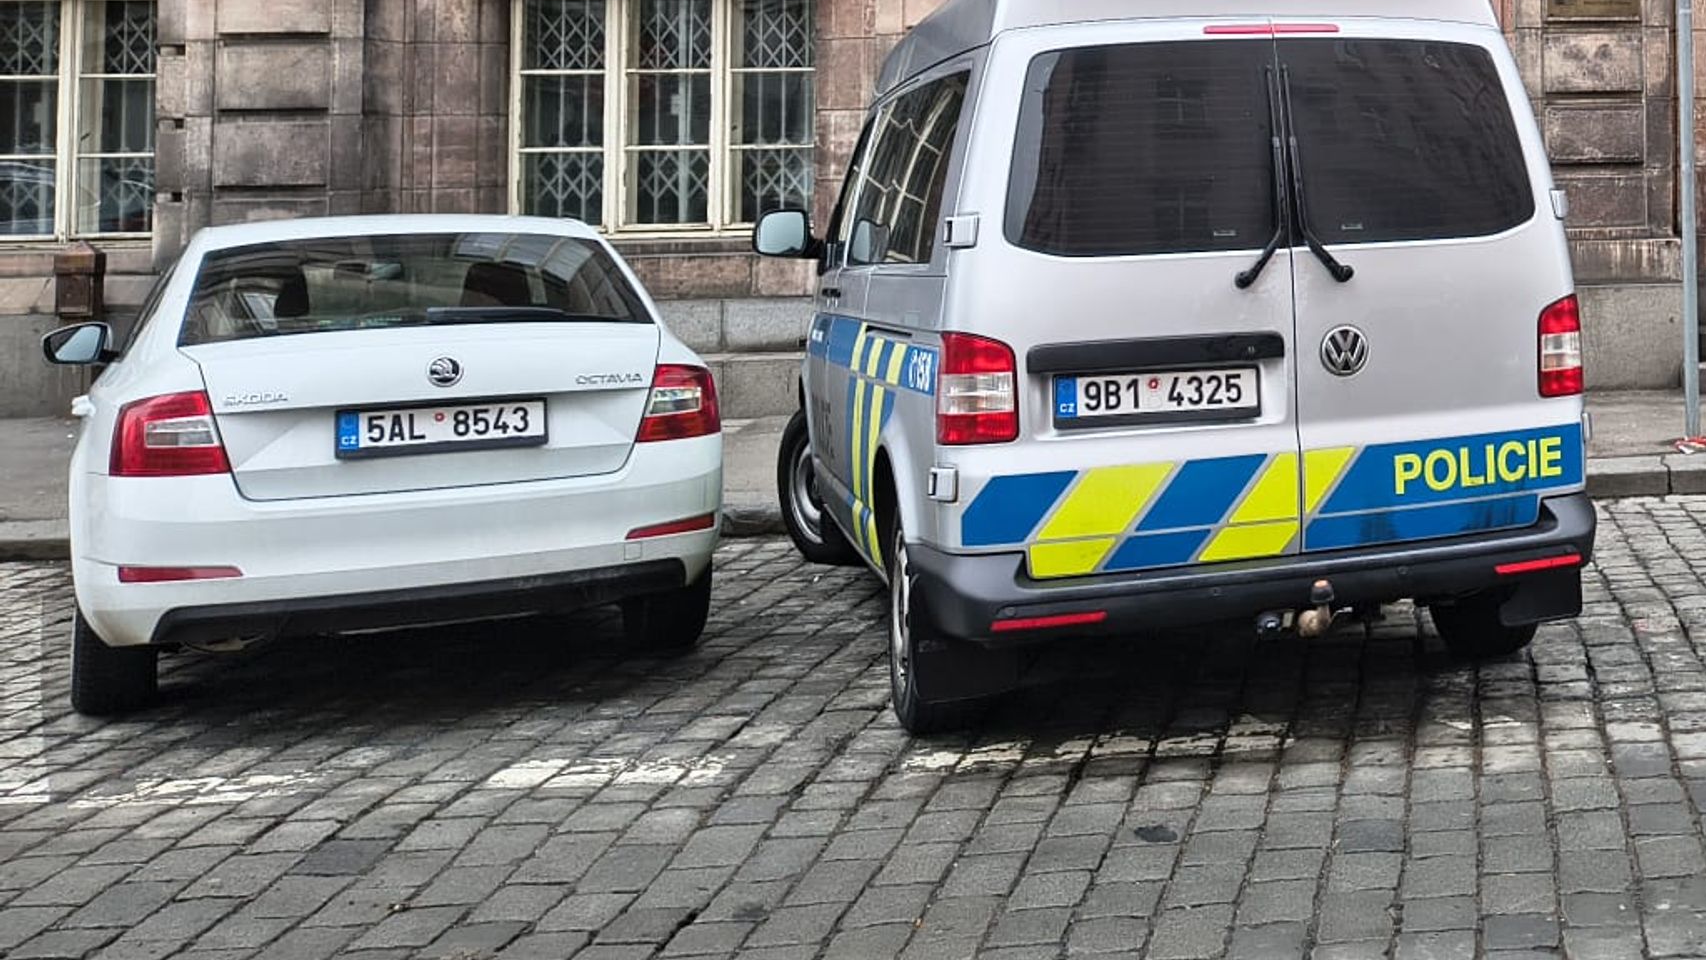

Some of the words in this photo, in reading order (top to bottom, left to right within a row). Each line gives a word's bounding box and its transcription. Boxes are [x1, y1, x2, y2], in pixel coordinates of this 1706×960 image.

[575, 373, 643, 385] OCTAVIA
[1059, 403, 1075, 413] CZ
[1084, 378, 1139, 411] 9B1
[1168, 373, 1242, 407] 4325
[341, 436, 357, 445] CZ
[367, 413, 426, 442] 5AL
[453, 406, 529, 437] 8543
[1393, 436, 1562, 495] POLICIE
